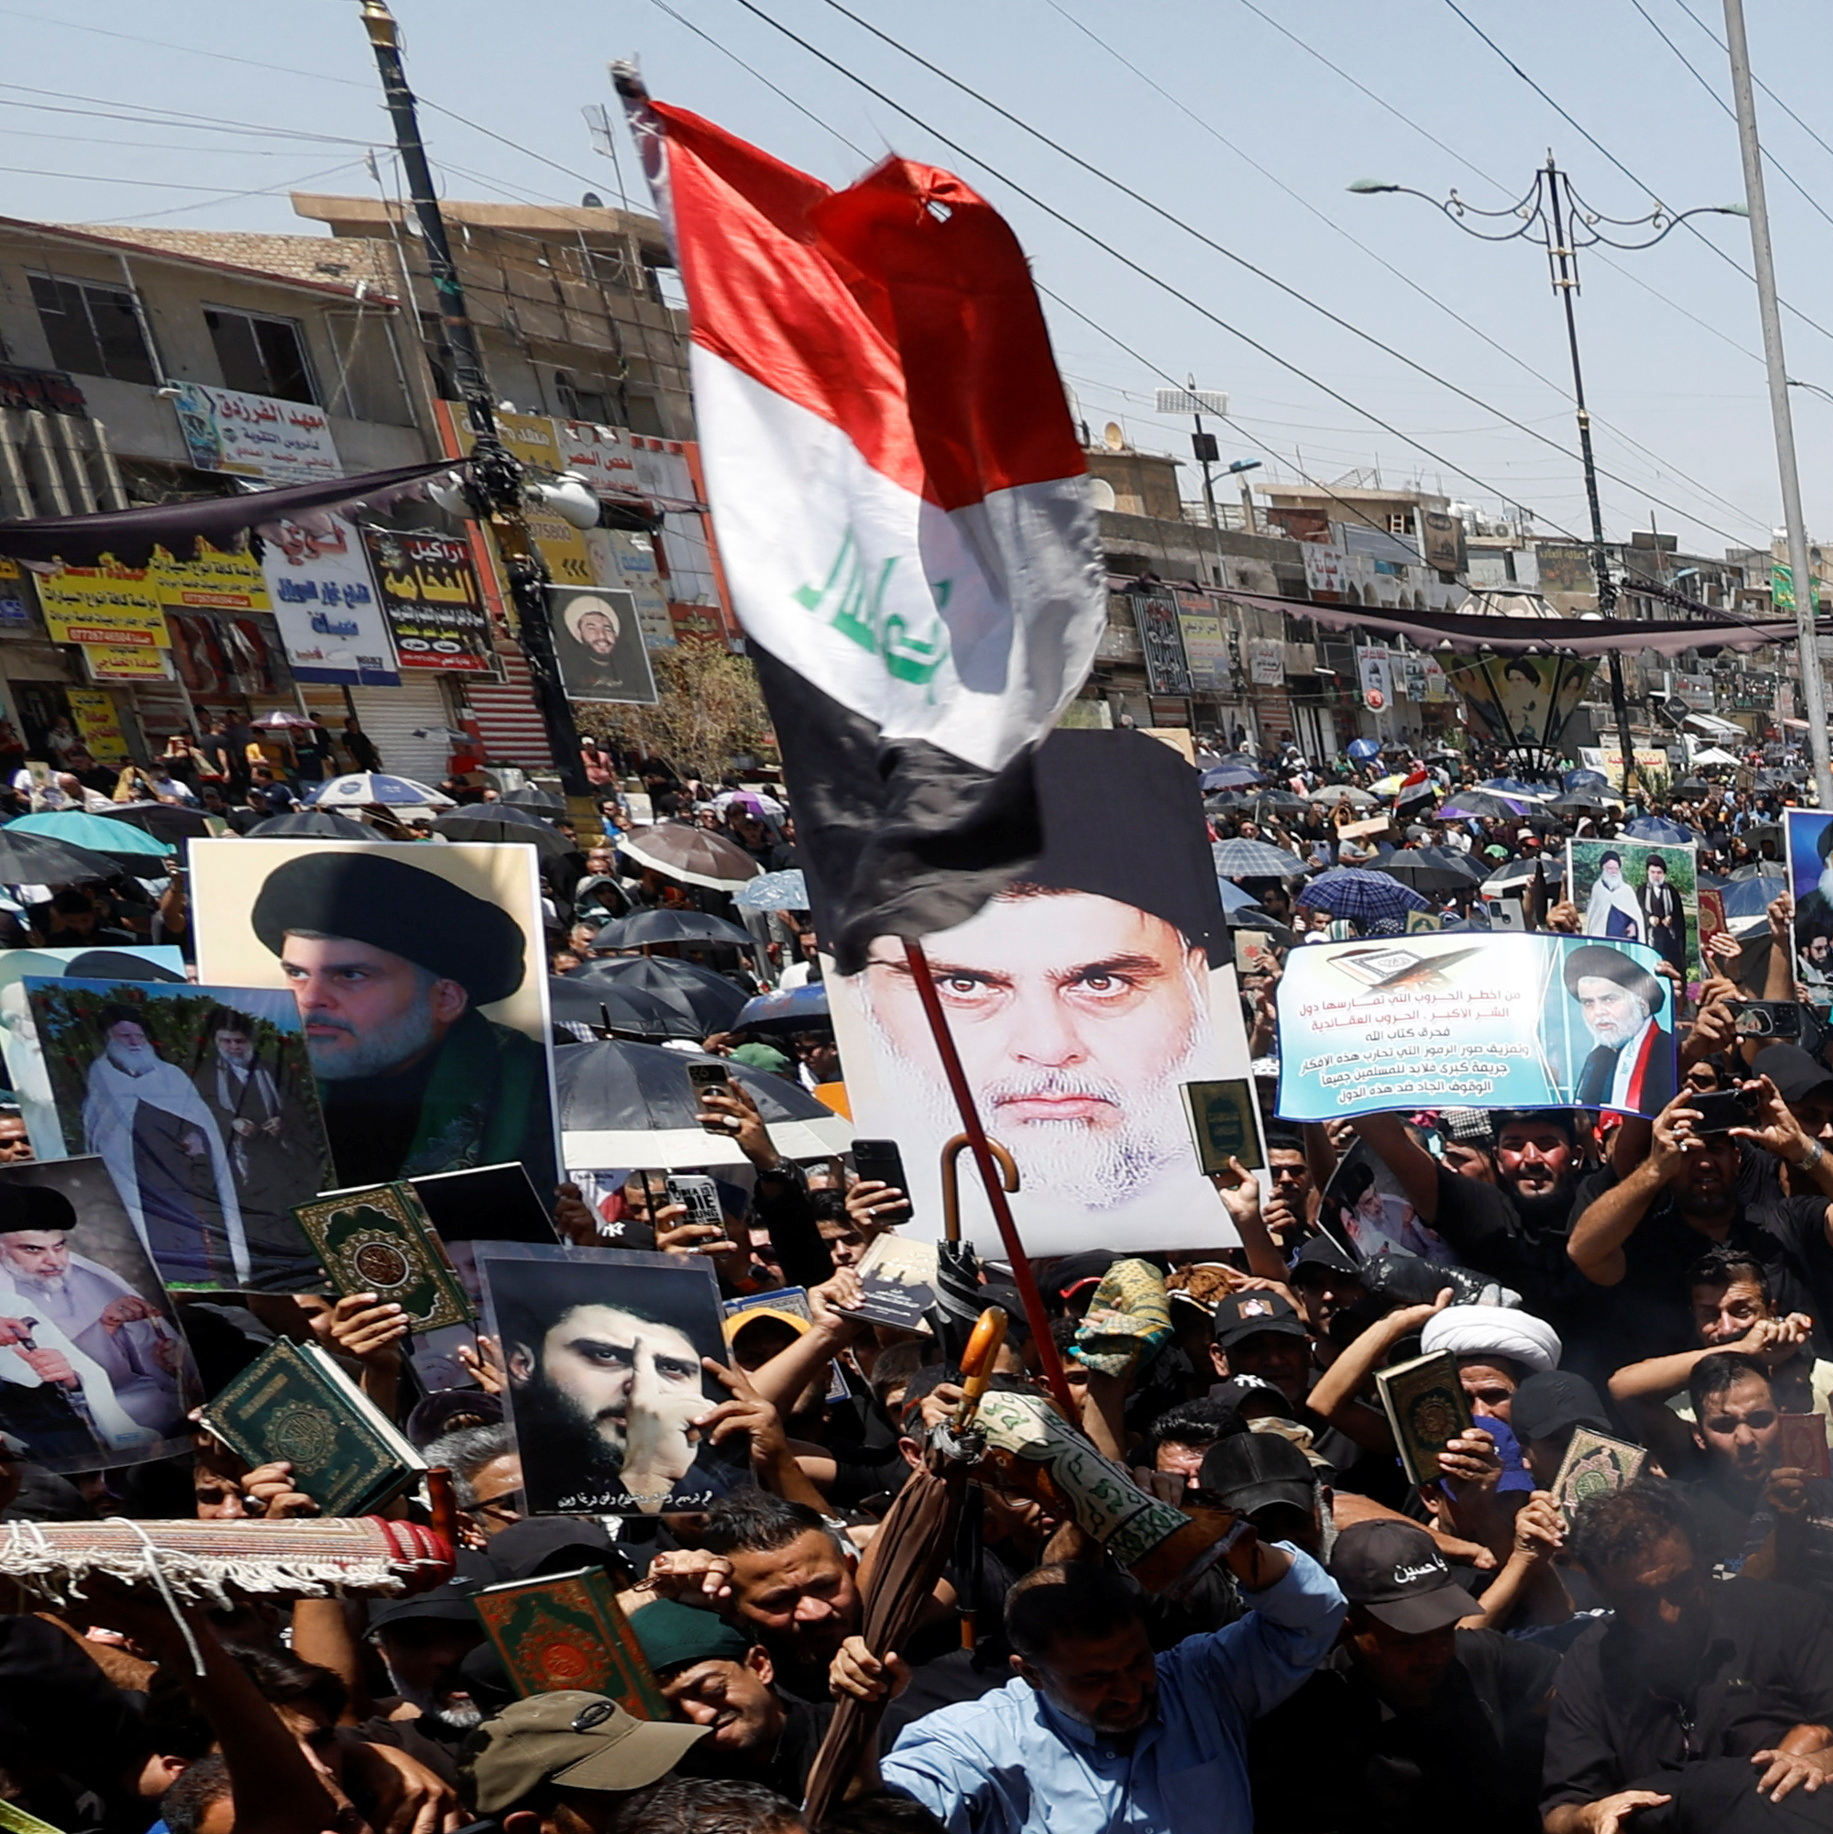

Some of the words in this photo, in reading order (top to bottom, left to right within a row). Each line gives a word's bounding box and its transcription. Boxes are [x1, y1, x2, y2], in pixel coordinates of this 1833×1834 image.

[288, 410, 326, 433] معهد
[567, 451, 602, 470] البصر
[1388, 993, 1411, 1005] التي
[1414, 990, 1464, 1005] الحروب
[1468, 989, 1501, 1003] اخطر
[1504, 991, 1521, 1002] من
[1299, 1003, 1320, 1018] دول
[1431, 1008, 1472, 1023] الاكبر
[1476, 1006, 1510, 1021] الشر
[1375, 1010, 1420, 1026] الحروب
[1365, 1030, 1384, 1042] الله
[1386, 1028, 1415, 1041] كتاب
[1363, 1048, 1393, 1061] تحارب
[1396, 1046, 1421, 1059] التي
[1424, 1044, 1458, 1058] الرموز
[1460, 1045, 1483, 1057] صور
[1301, 1055, 1333, 1075] الافكار
[1336, 1053, 1360, 1064] هذه
[1353, 1065, 1405, 1081] للمسلمين
[1439, 1061, 1469, 1075] كبرى
[1471, 1061, 1508, 1075] جريمة
[1368, 1086, 1393, 1096] هذه
[1396, 1083, 1415, 1092] ضد
[1416, 1081, 1445, 1094] الجاد
[1447, 1081, 1492, 1095] الوقوف
[1339, 1087, 1366, 1103] الدول
[1431, 1552, 1449, 1573] يا
[1394, 1562, 1438, 1584] حسين
